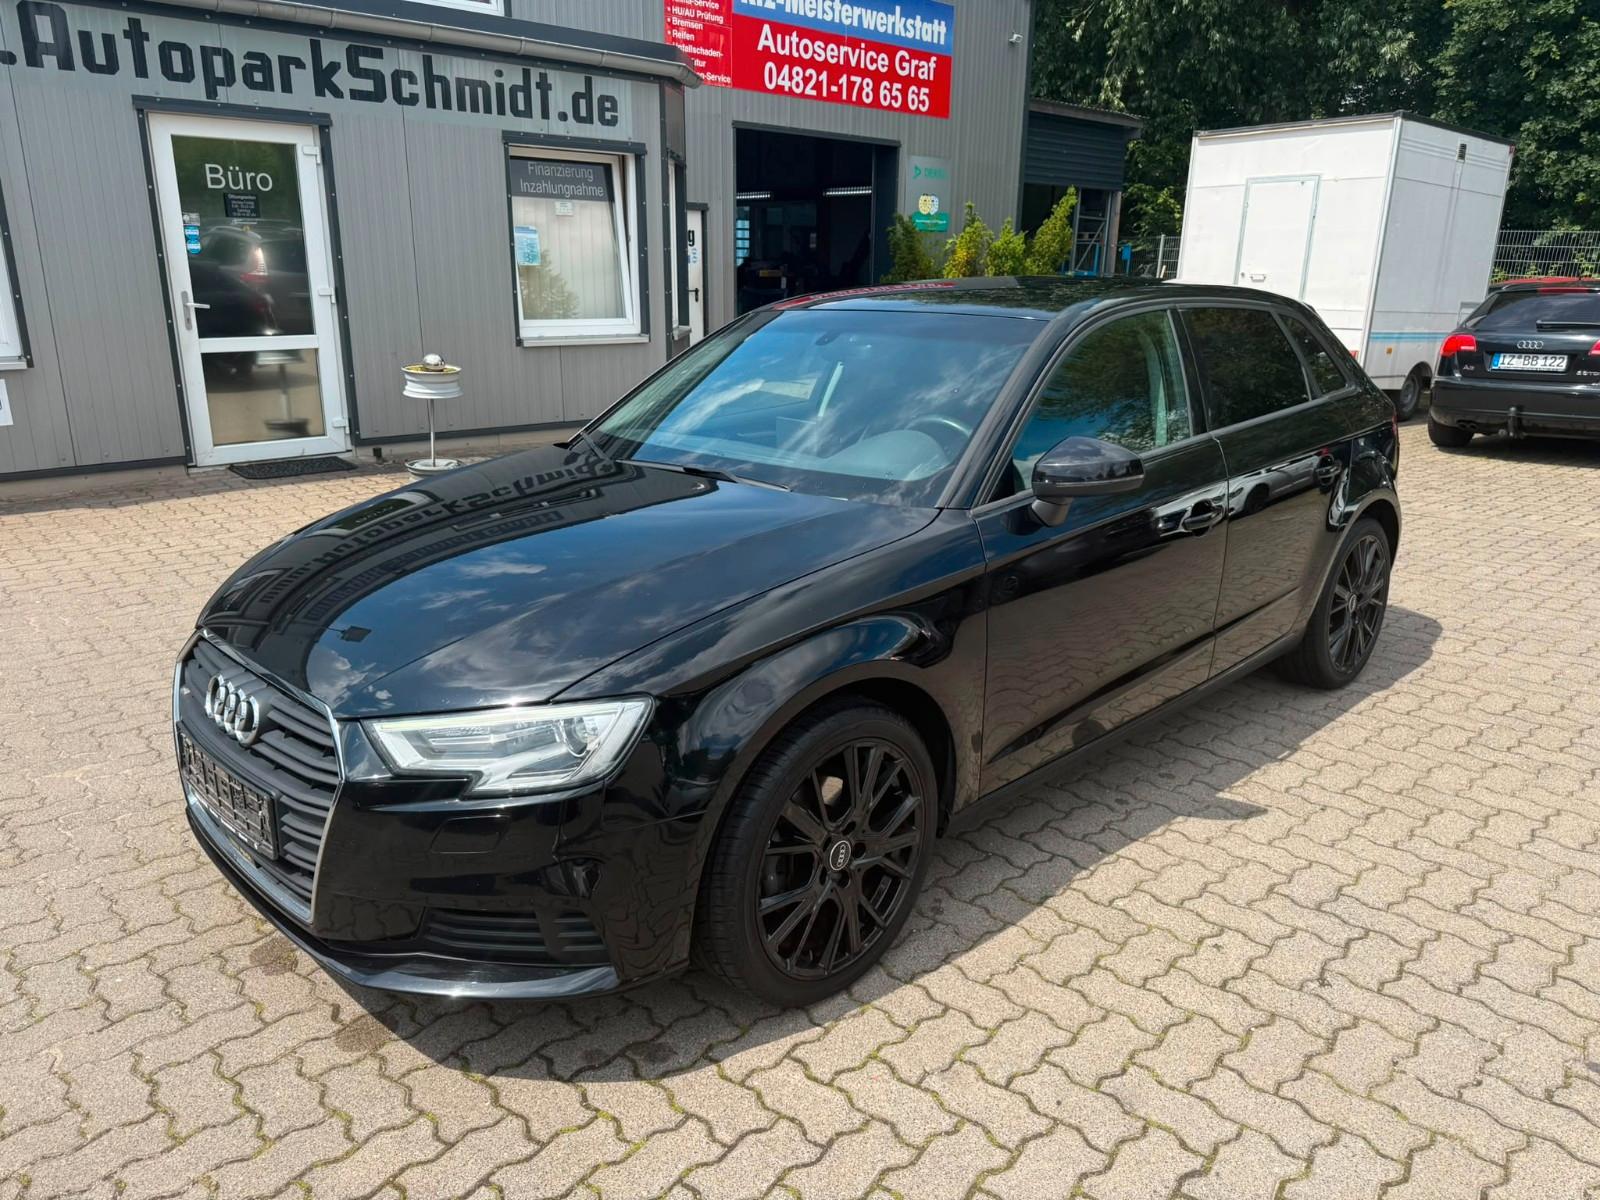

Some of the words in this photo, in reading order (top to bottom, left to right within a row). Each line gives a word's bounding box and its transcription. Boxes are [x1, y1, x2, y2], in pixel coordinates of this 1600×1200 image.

[672, 17, 703, 30] Bremsen
[696, 10, 724, 24] Prüfung
[741, 0, 946, 45] -eisterwerkstatt
[672, 29, 695, 41] Reifen
[757, 23, 889, 73] Autoservice
[895, 50, 937, 81] Graf
[764, 61, 873, 104] 04821-178
[879, 81, 902, 108] 65
[907, 85, 930, 112] 65
[205, 163, 272, 191] Büro
[527, 161, 594, 182] Finanzierung
[520, 178, 604, 198] Inzahlungnahme
[1522, 355, 1539, 367] BB
[1542, 356, 1566, 368] 122
